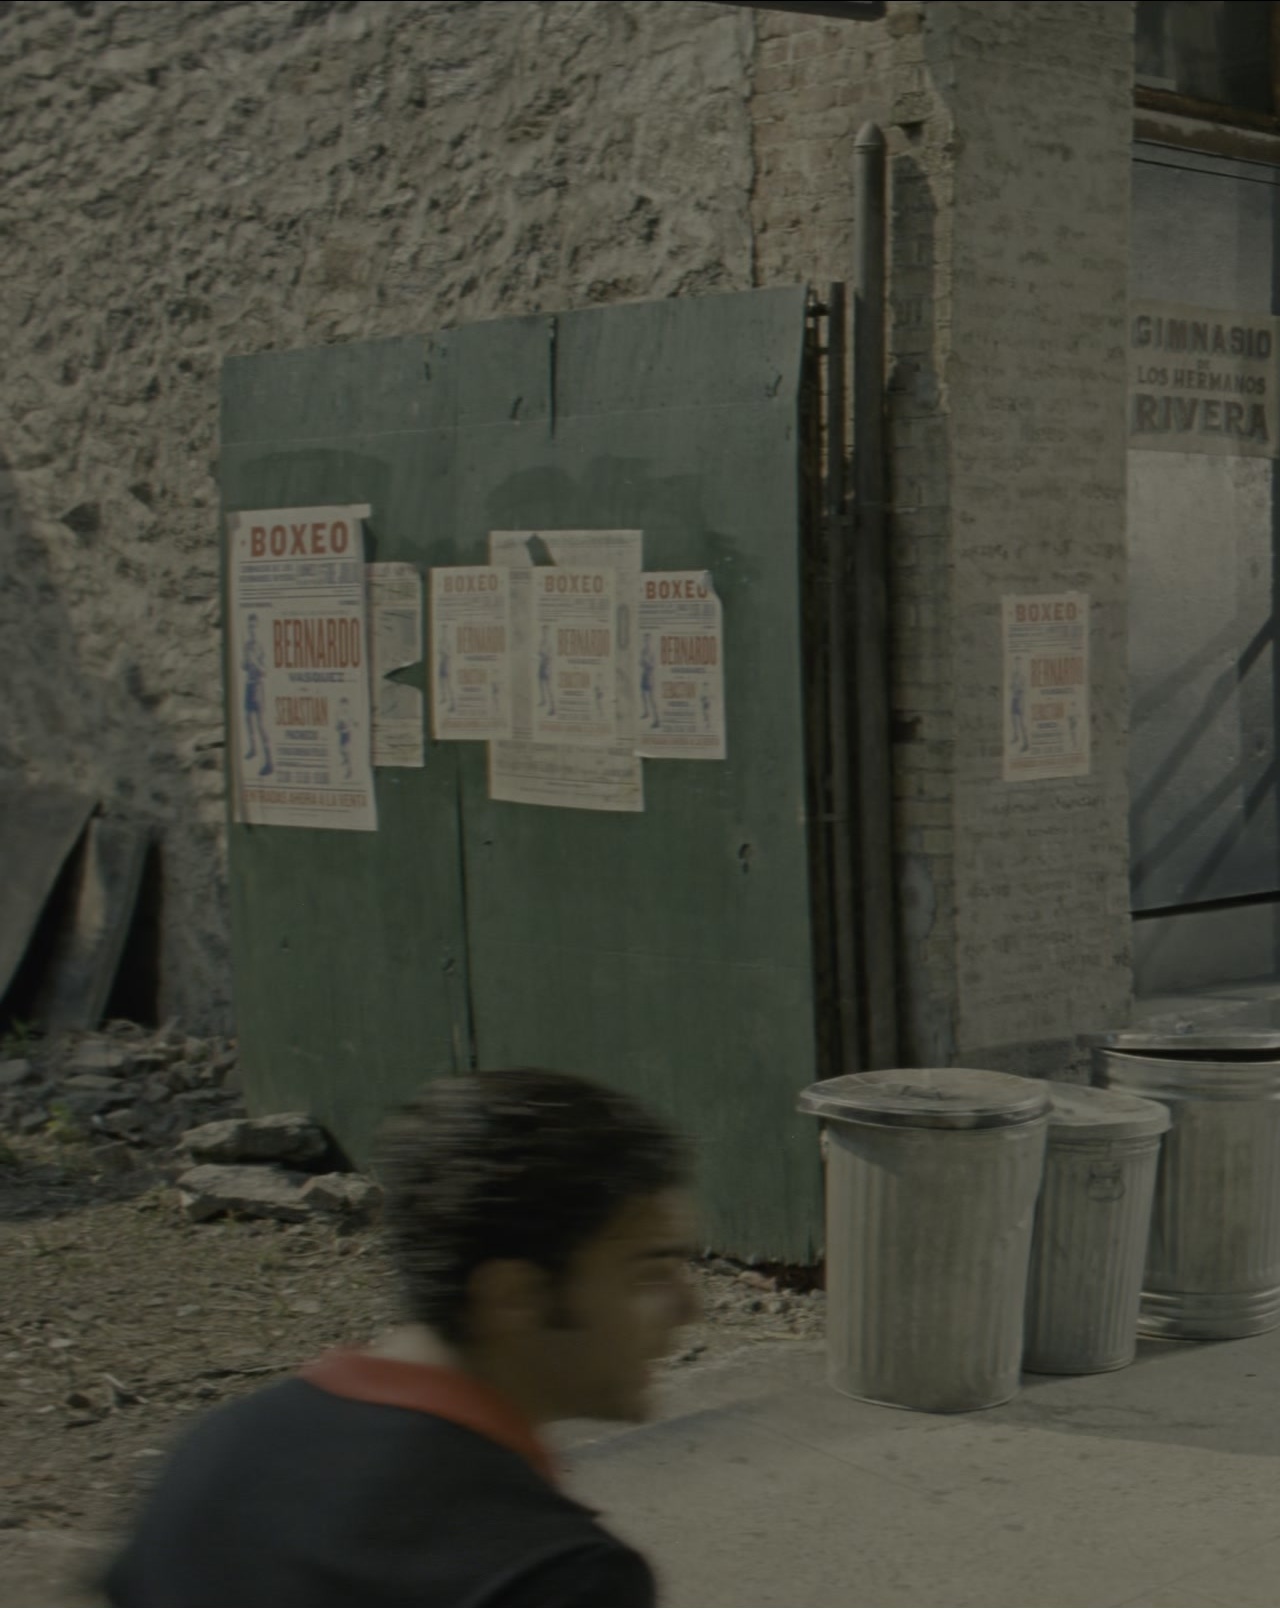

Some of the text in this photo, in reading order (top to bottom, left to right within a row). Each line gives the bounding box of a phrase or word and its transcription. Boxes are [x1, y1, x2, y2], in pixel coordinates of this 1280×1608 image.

[1134, 315, 1271, 359] GIMNASIO
[1137, 366, 1266, 395] LOS HERMANOS
[1133, 393, 1268, 443] RIVERA
[251, 521, 349, 558] BOXEO
[443, 574, 498, 593] BOXEO
[544, 575, 604, 593] BOXEO
[646, 580, 709, 600] BOXEO
[1015, 602, 1078, 622] BOXEO
[273, 618, 361, 669] BERNARDO
